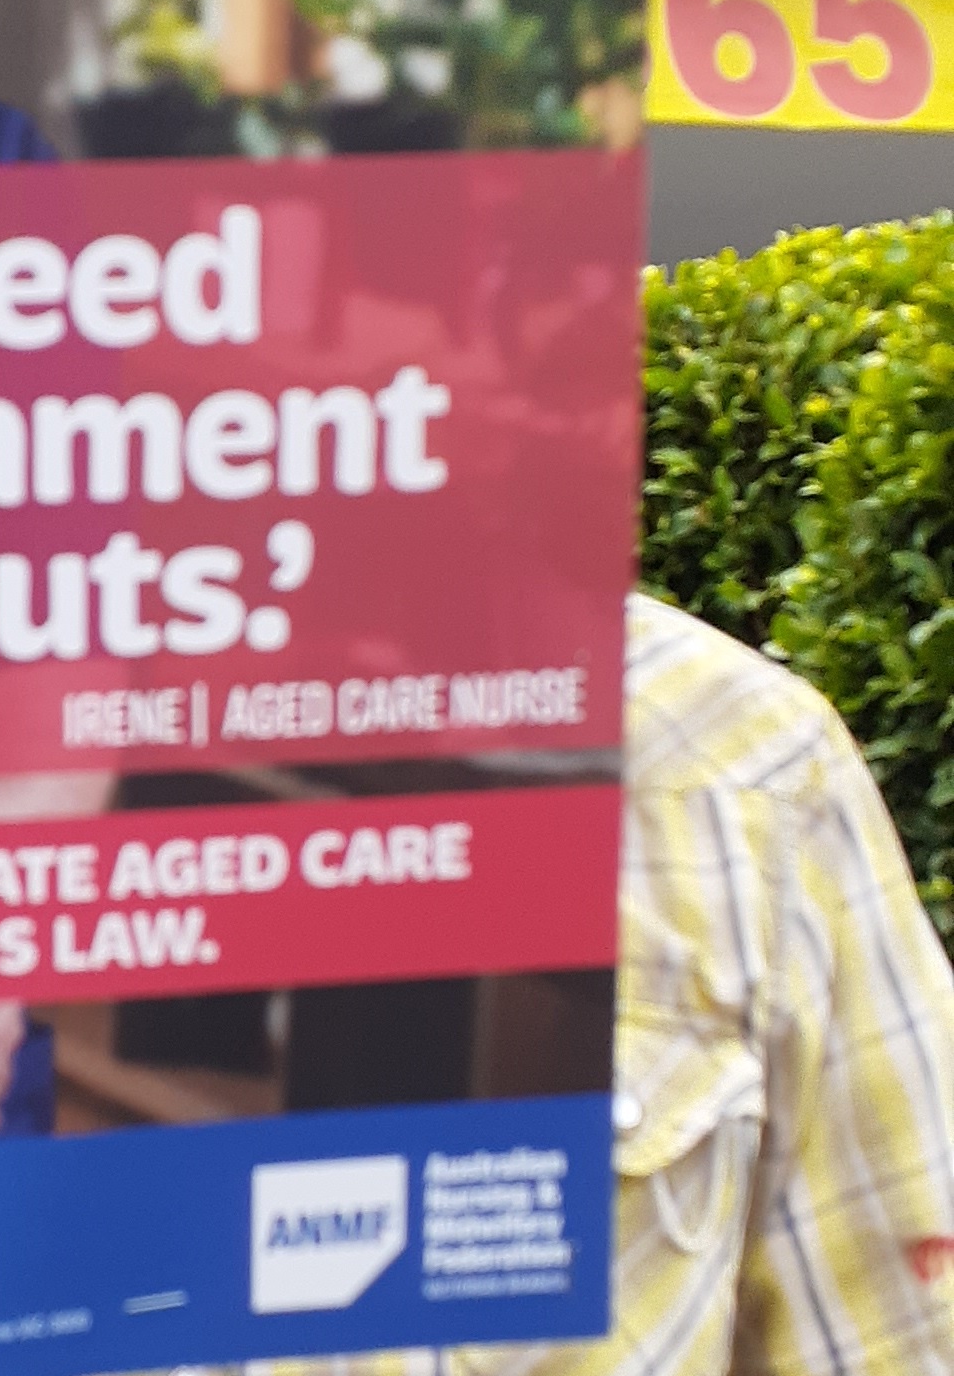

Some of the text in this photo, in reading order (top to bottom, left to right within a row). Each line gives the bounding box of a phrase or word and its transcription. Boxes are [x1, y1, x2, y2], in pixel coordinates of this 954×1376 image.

[61, 689, 188, 749] IRENE
[220, 679, 334, 741] AGED
[336, 673, 448, 736] CARE
[448, 665, 588, 730] NURSE
[108, 833, 291, 900] AGED
[299, 822, 474, 889] CARE
[50, 906, 222, 974] LAW.
[265, 1208, 388, 1250] ANMF
